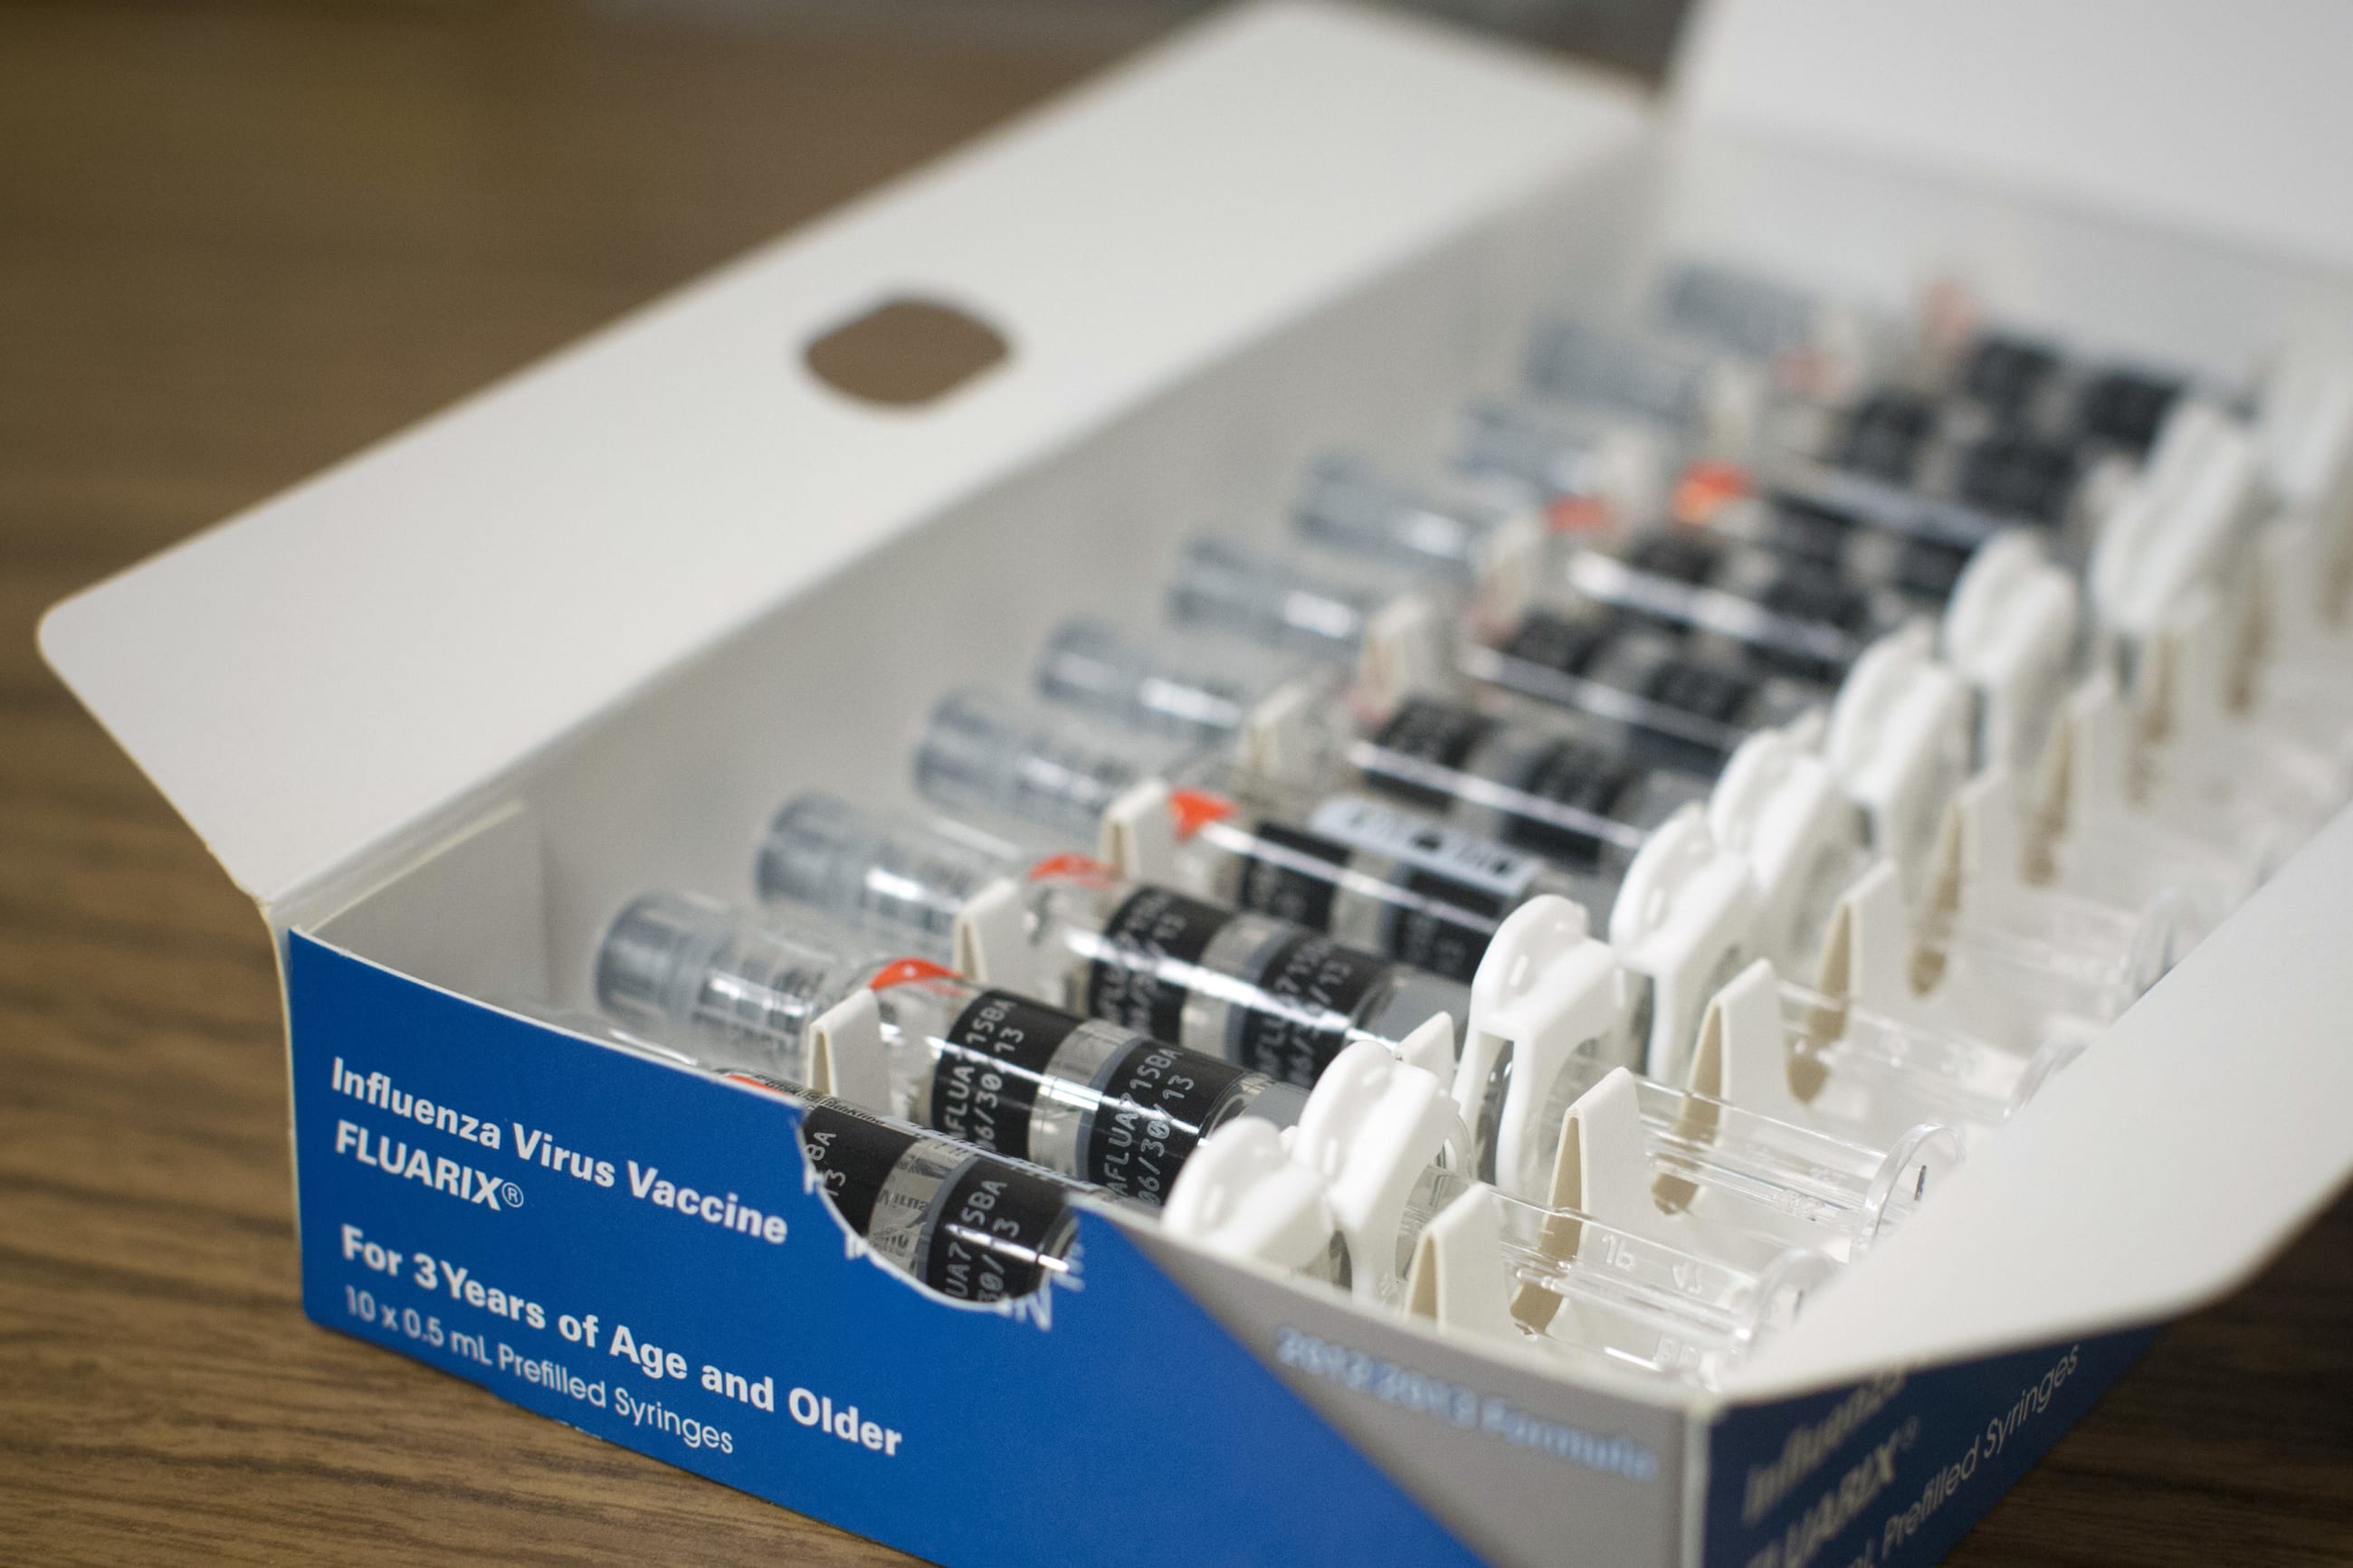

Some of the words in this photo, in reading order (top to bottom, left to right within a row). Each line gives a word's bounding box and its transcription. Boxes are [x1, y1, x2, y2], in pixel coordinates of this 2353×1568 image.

[331, 1057, 500, 1150] Influenza
[513, 1122, 615, 1188] Virus
[627, 1160, 788, 1245] Vaccine
[341, 1223, 402, 1276] For
[413, 1252, 438, 1289] 3
[440, 1259, 546, 1329] Years
[558, 1314, 599, 1347] of
[609, 1325, 688, 1380] Age
[701, 1364, 774, 1412] and
[788, 1387, 901, 1456] Older
[345, 1284, 376, 1322] 10
[380, 1304, 398, 1331] x
[403, 1307, 444, 1347] 0.5
[451, 1330, 492, 1365] mL
[498, 1342, 605, 1408] Prefilled
[614, 1386, 733, 1454] Syringes
[1881, 1435, 1980, 1560] Prefilled
[1983, 1344, 2080, 1459] Syringes
